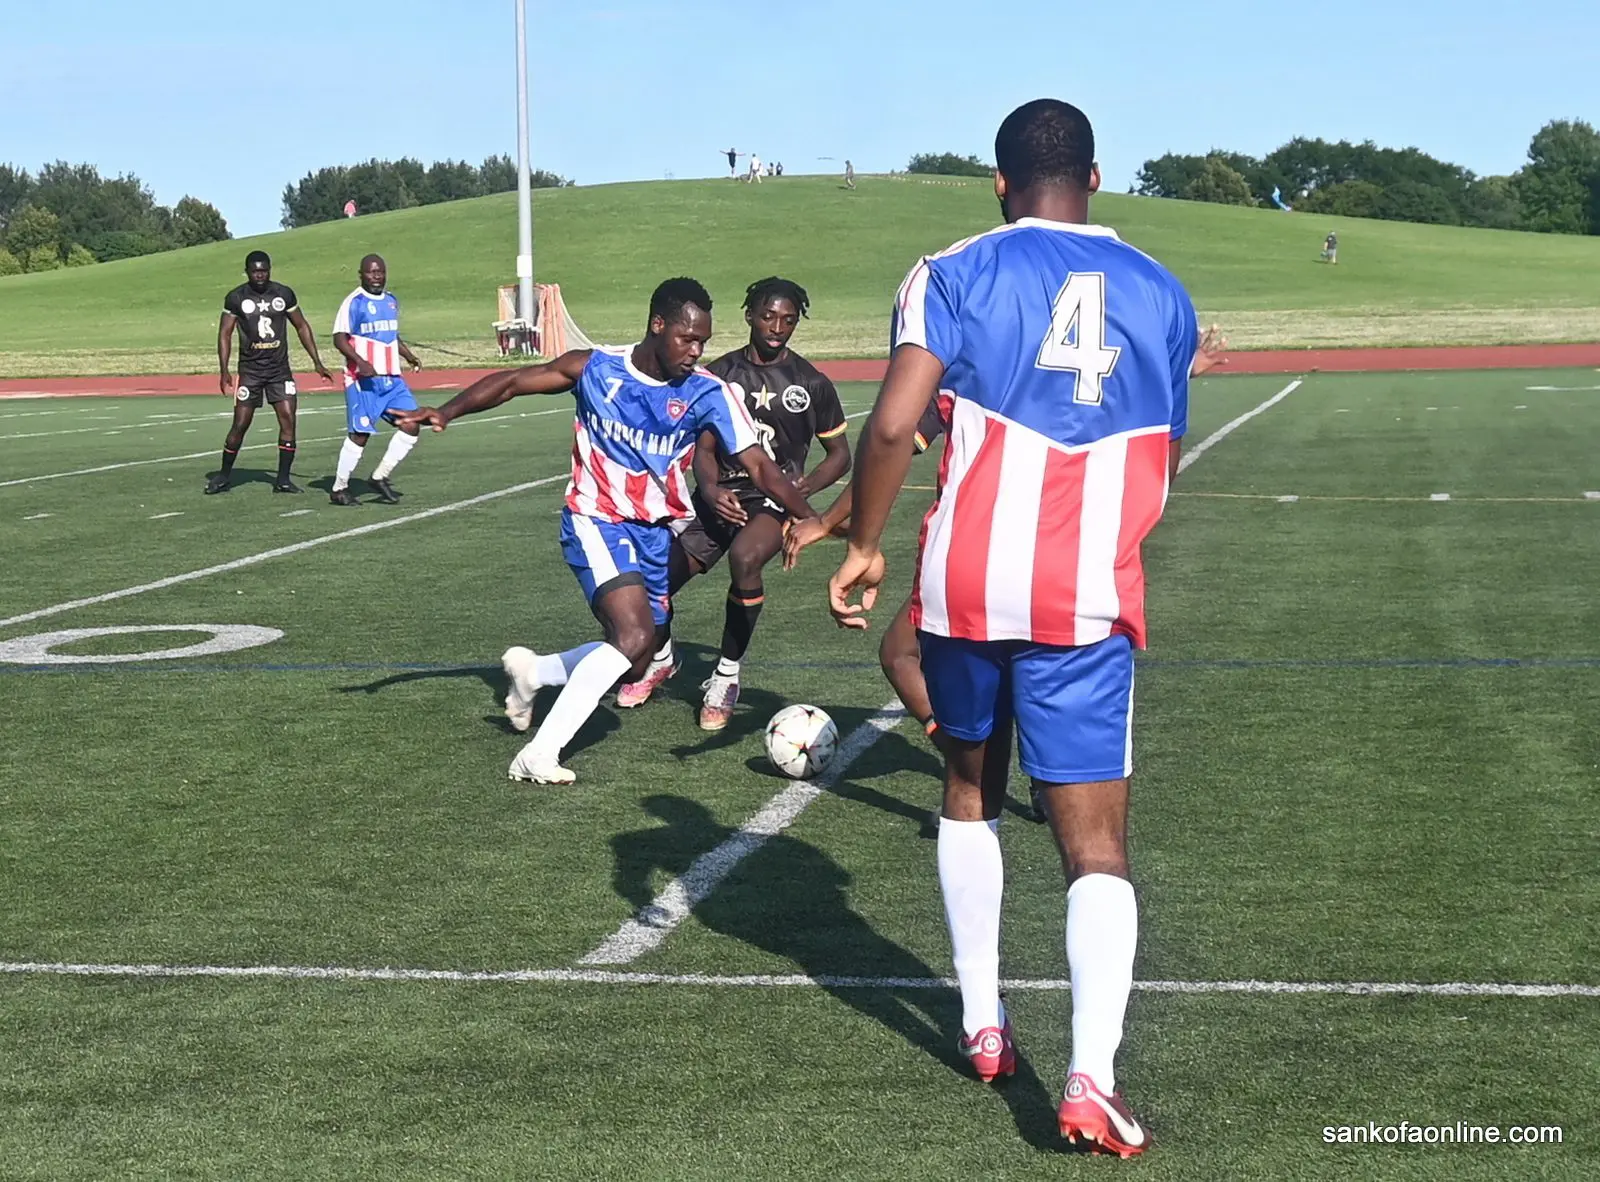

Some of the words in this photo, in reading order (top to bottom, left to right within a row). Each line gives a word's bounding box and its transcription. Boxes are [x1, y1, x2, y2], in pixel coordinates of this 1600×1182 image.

[367, 300, 377, 315] 6
[1034, 271, 1122, 406] 4
[603, 377, 624, 404] 7
